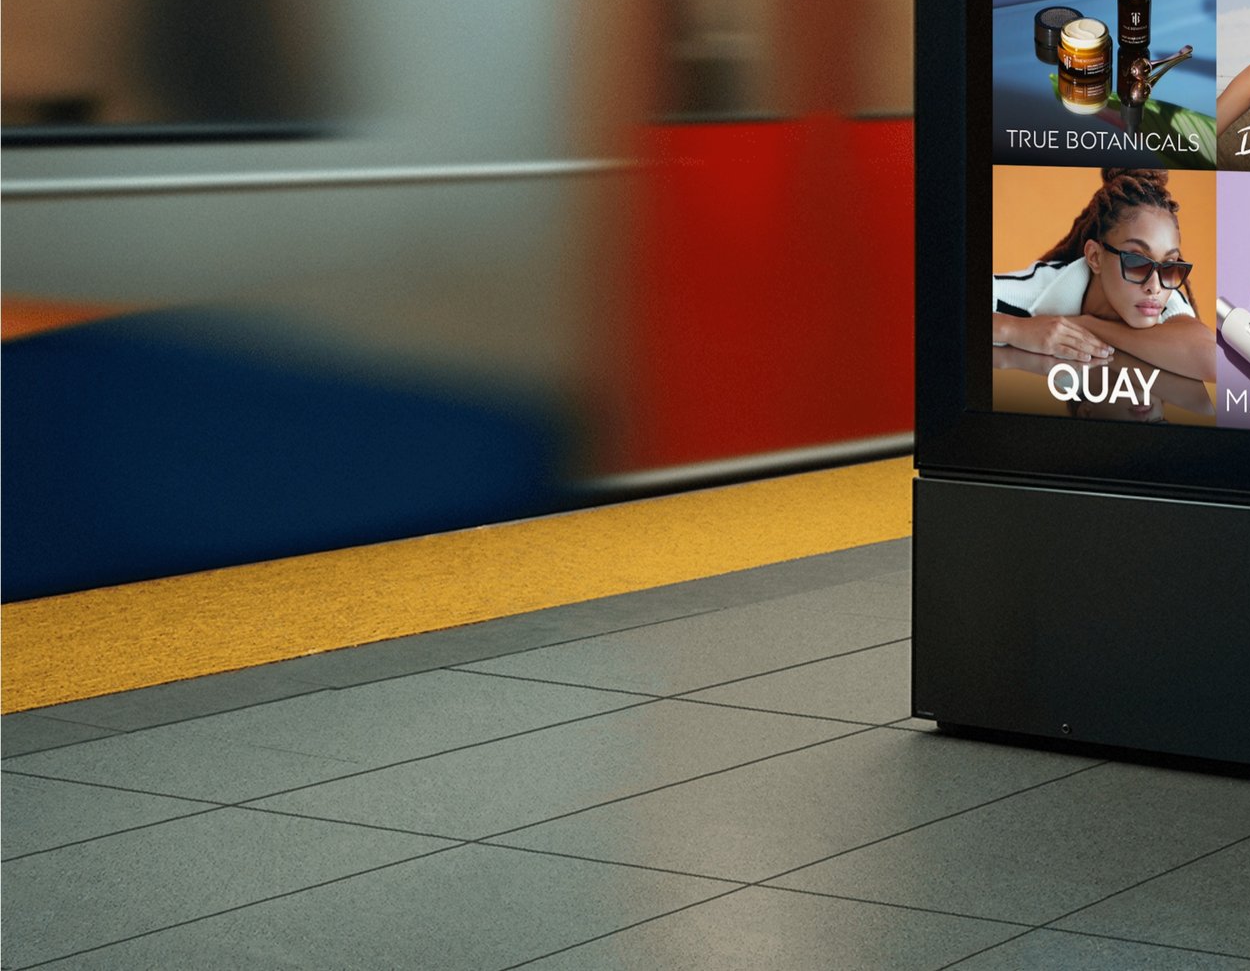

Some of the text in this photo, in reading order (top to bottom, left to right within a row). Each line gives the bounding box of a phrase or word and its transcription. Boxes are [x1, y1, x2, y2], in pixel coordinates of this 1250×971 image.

[1006, 129, 1201, 152] TRUE BOTANICALS
[1047, 363, 1161, 406] QUAY
